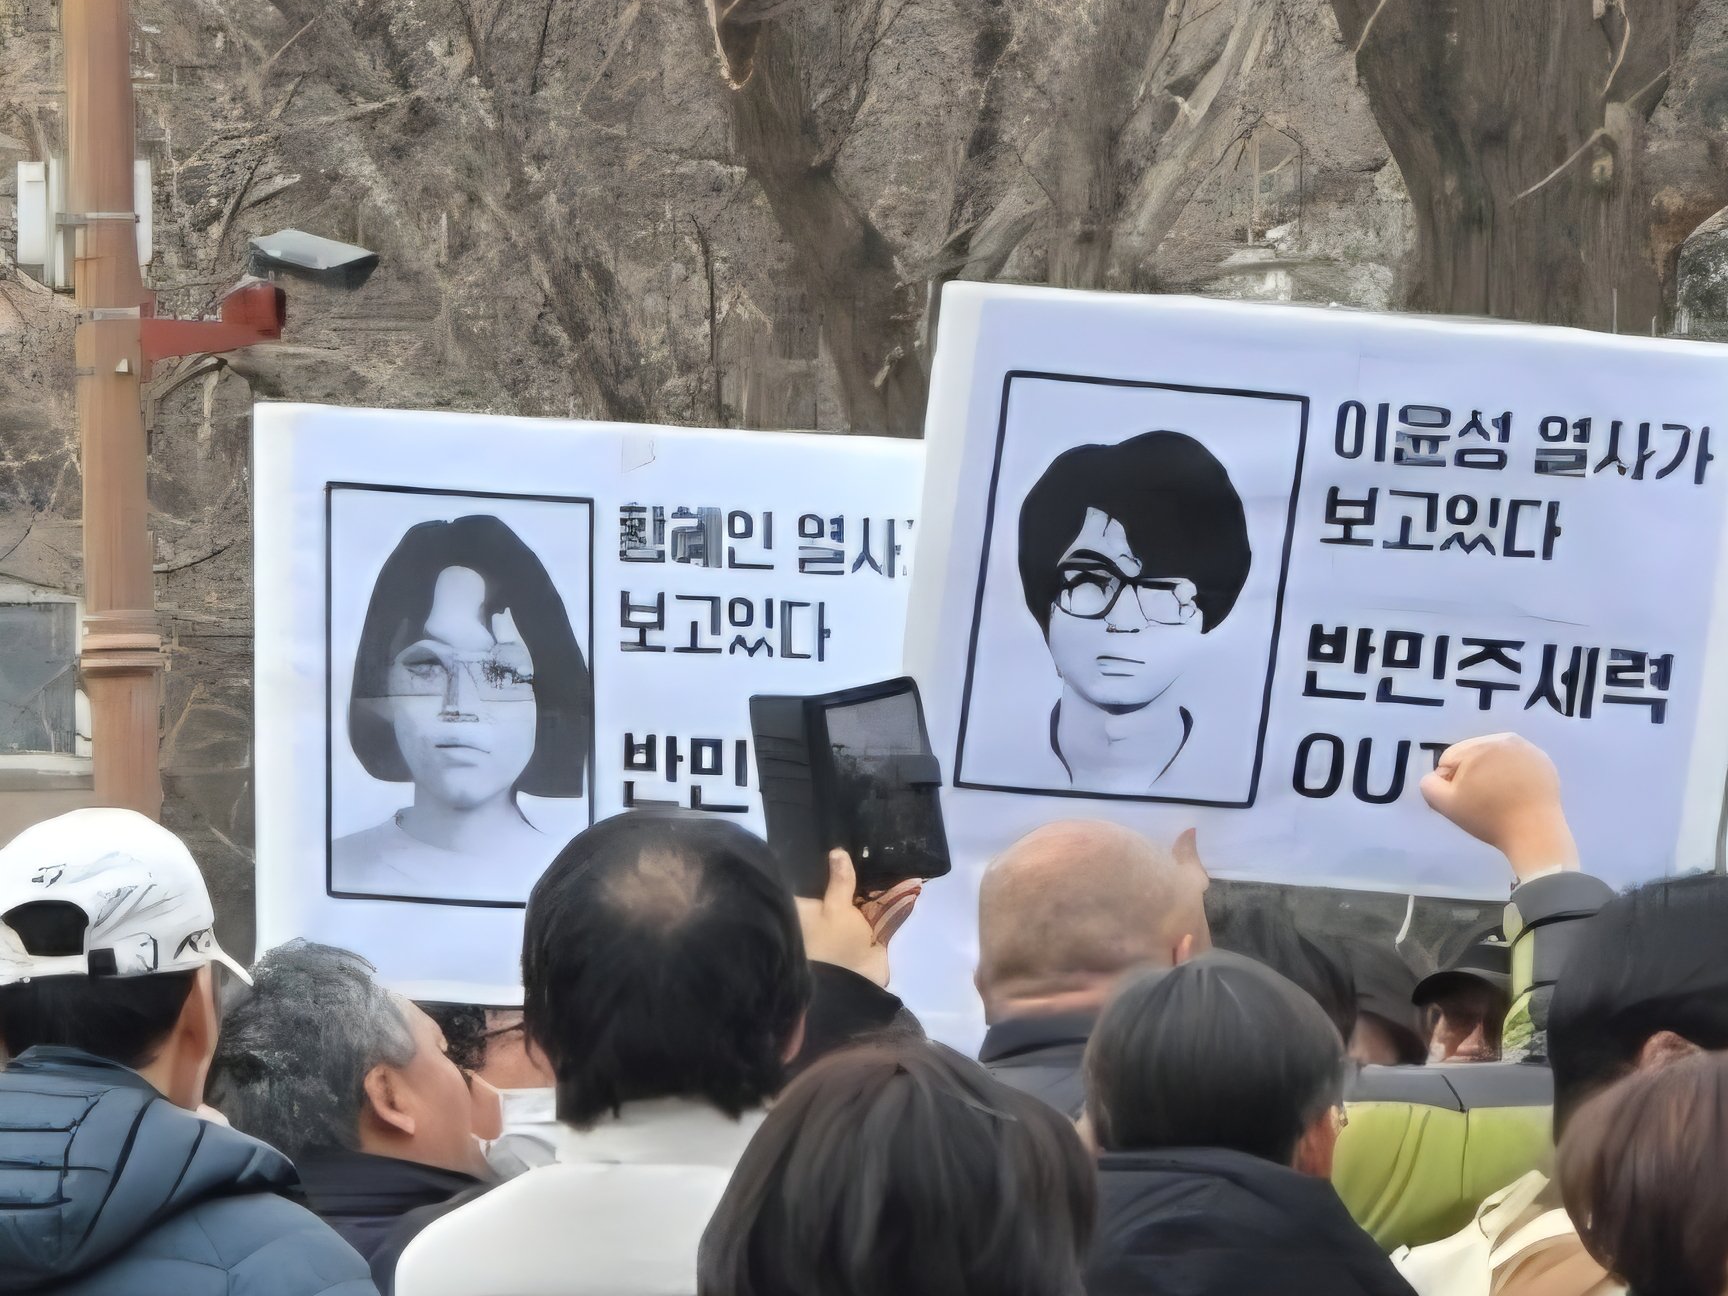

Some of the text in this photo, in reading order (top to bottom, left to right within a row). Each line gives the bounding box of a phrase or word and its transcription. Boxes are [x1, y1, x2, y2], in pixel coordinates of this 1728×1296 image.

[1334, 400, 1714, 485] 이윤성 열사가
[798, 514, 915, 579] 열사
[1320, 486, 1562, 561] 보고있다
[619, 590, 832, 662] 보고있다
[1301, 623, 1676, 725] 반민주세력
[622, 732, 750, 814] 반민
